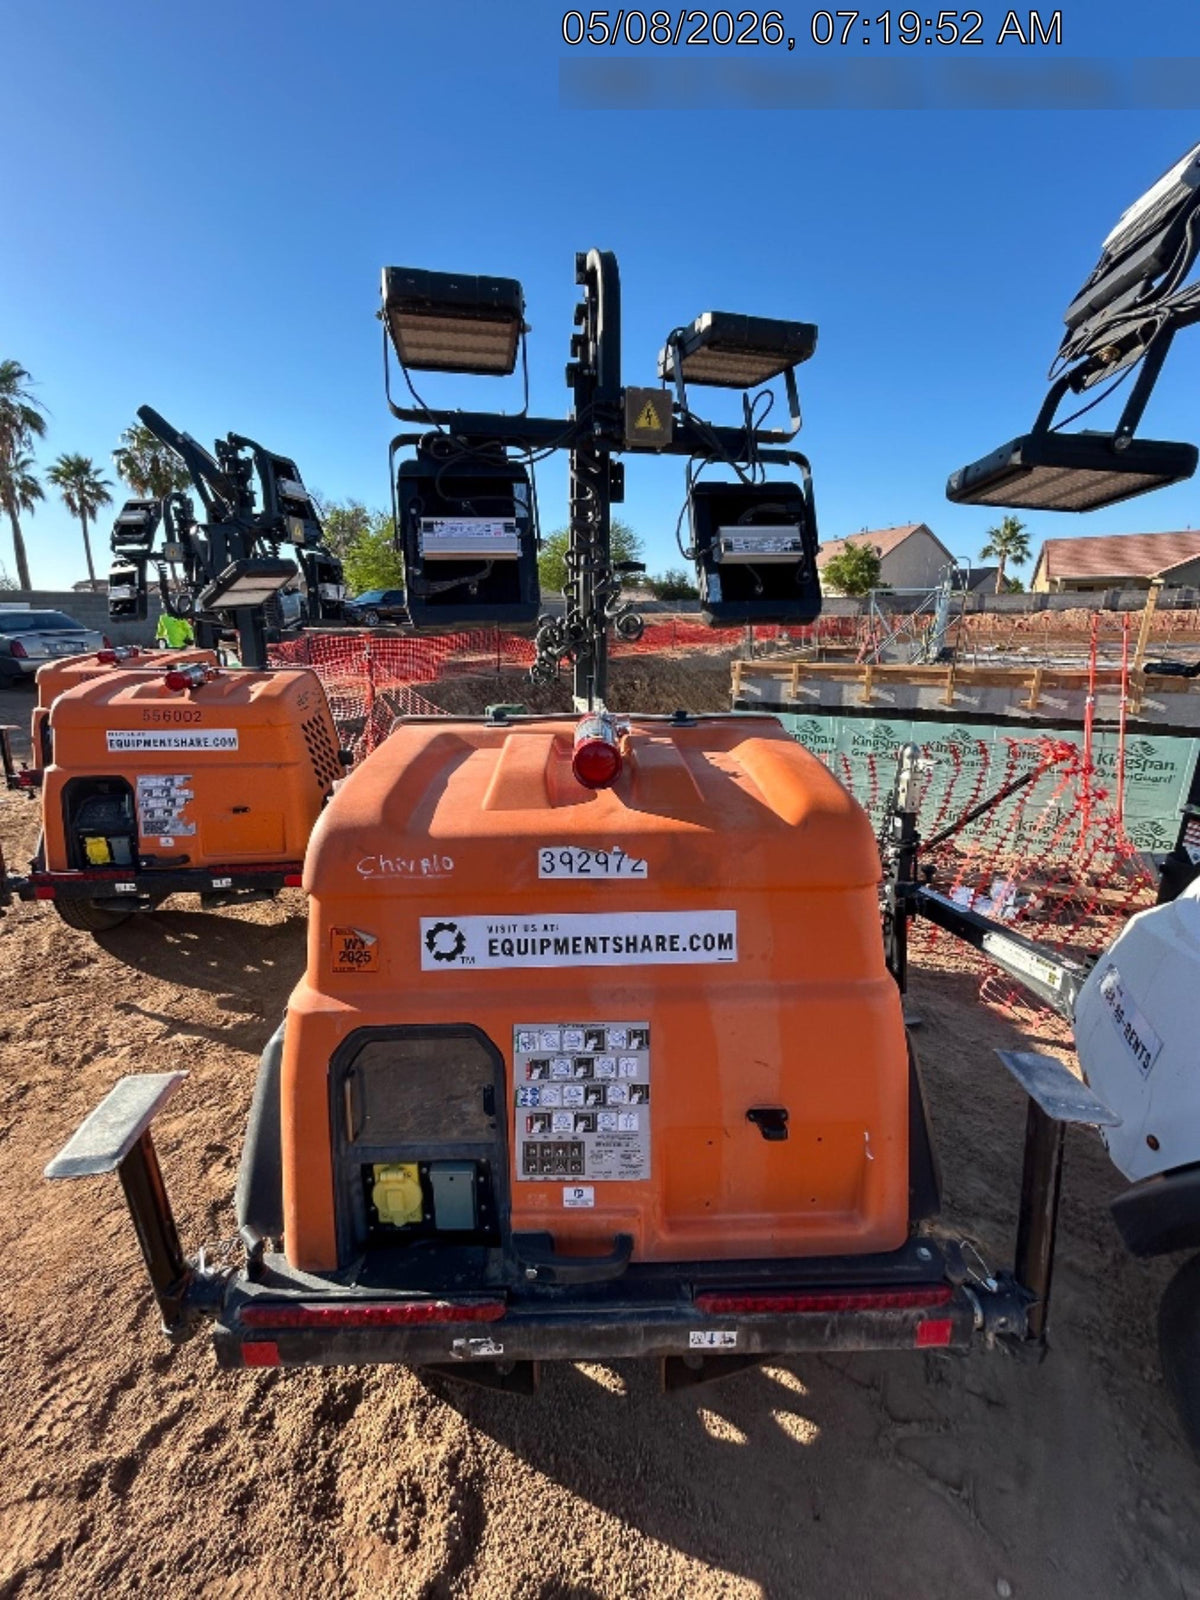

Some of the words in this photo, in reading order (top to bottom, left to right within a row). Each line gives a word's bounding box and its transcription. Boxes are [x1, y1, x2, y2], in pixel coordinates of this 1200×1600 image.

[143, 709, 202, 723] 556002
[109, 737, 237, 749] EQUIPMENTSHARE.COM
[541, 851, 644, 873] 392972
[487, 924, 518, 935] VISIT
[523, 924, 538, 933] US
[488, 932, 735, 957] EQUIPMENTSHARE.COM
[338, 950, 372, 963] 2025
